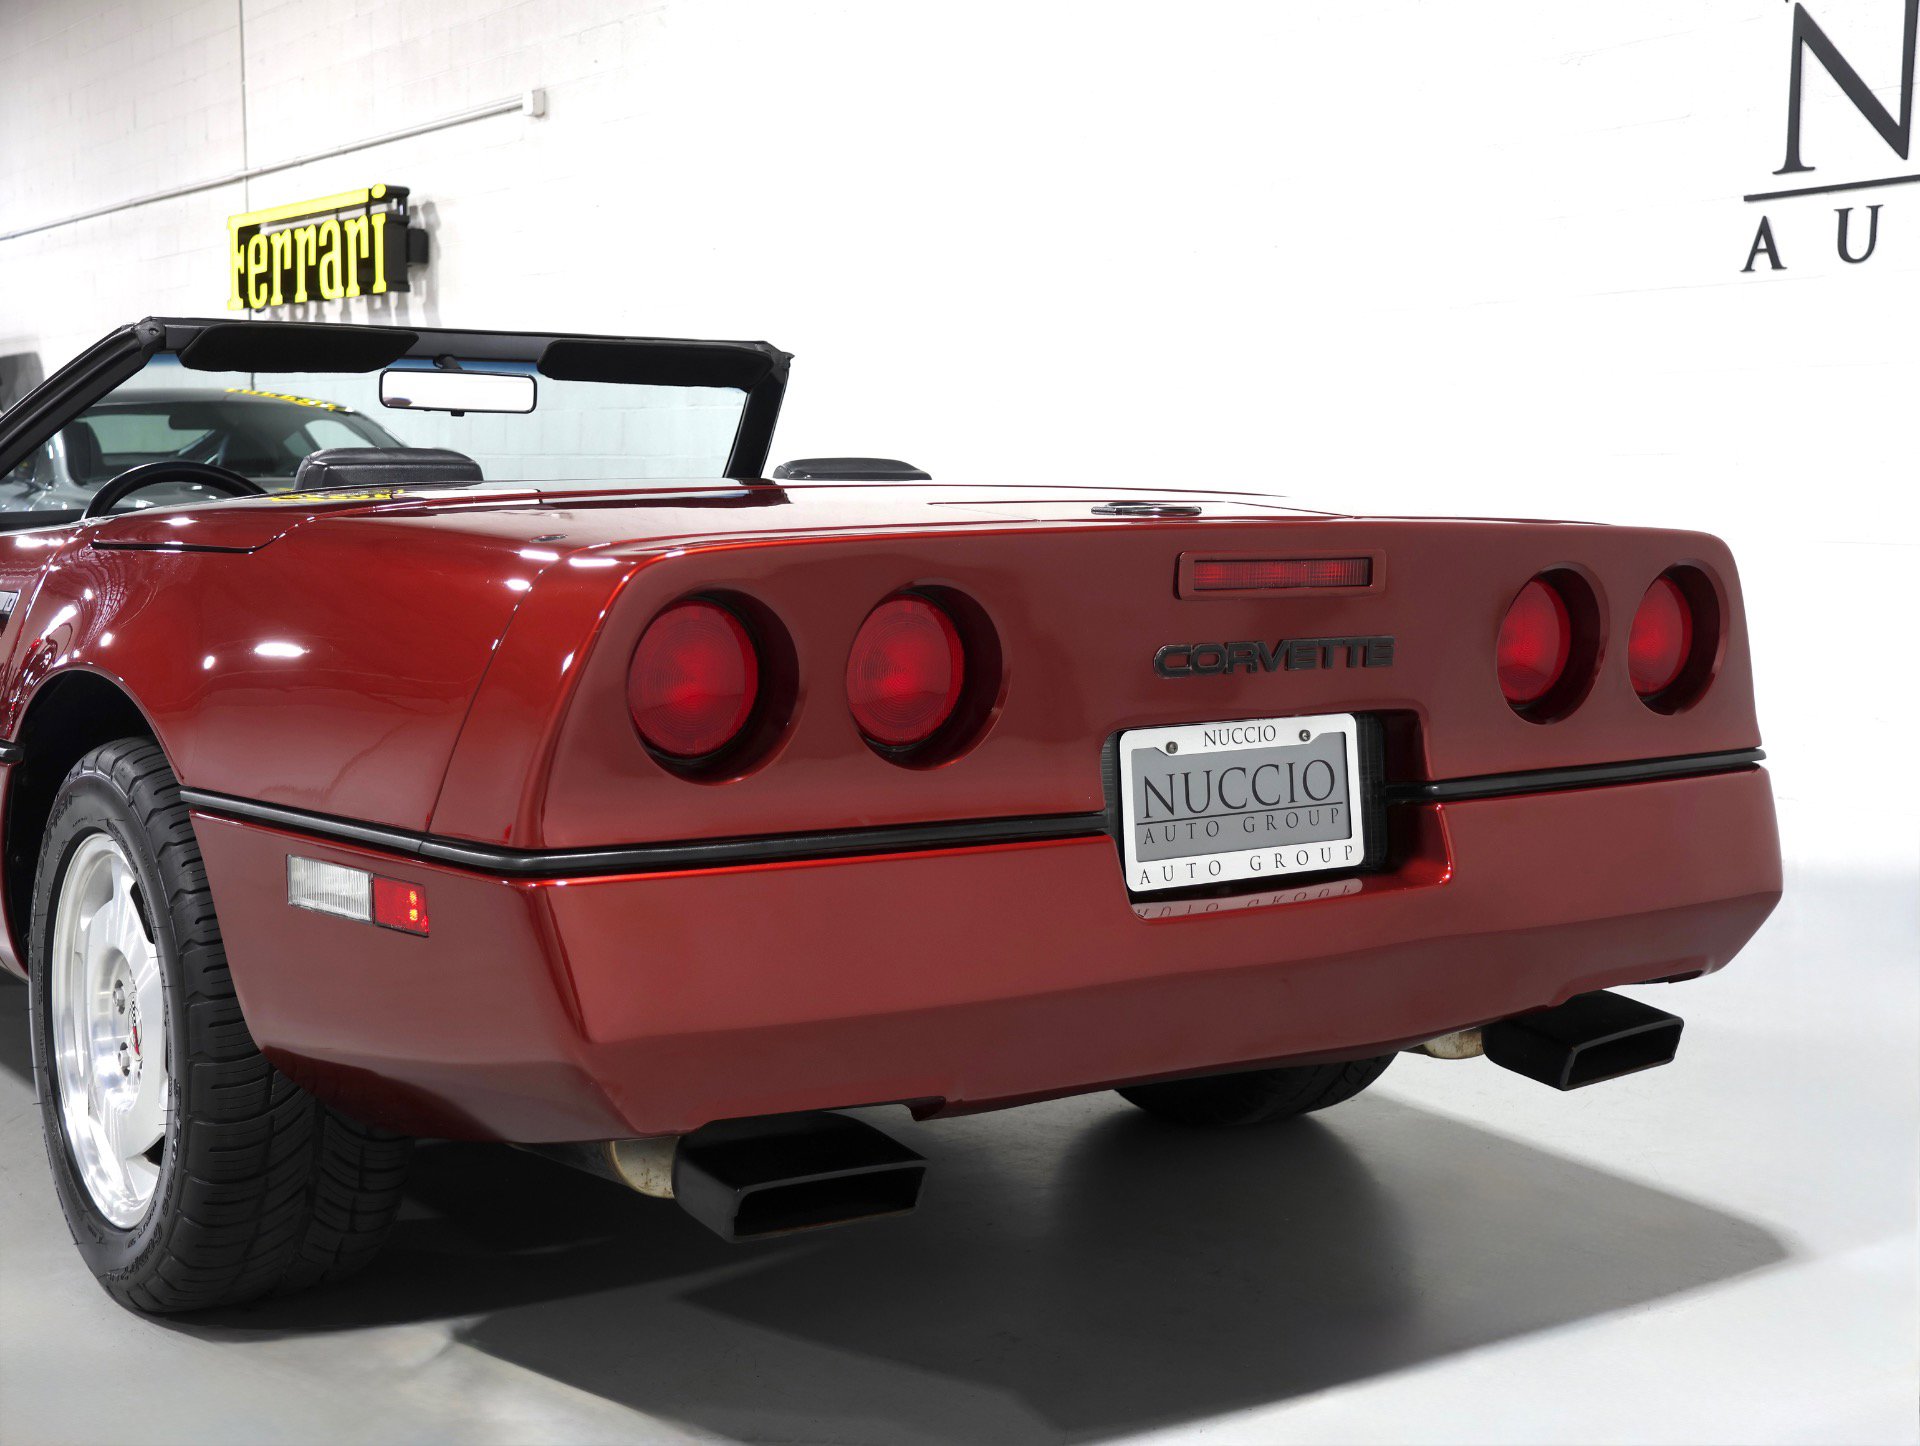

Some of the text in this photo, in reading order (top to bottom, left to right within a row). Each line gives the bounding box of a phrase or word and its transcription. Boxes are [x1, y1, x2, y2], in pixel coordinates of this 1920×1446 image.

[227, 184, 387, 311] Ferrari
[1154, 636, 1395, 678] CORVETTE
[1203, 725, 1277, 748] NUCCIO
[1142, 759, 1336, 819] NUCCIO
[1143, 807, 1340, 846] AUTO GROUP
[1139, 844, 1353, 886] AUTO GROUP
